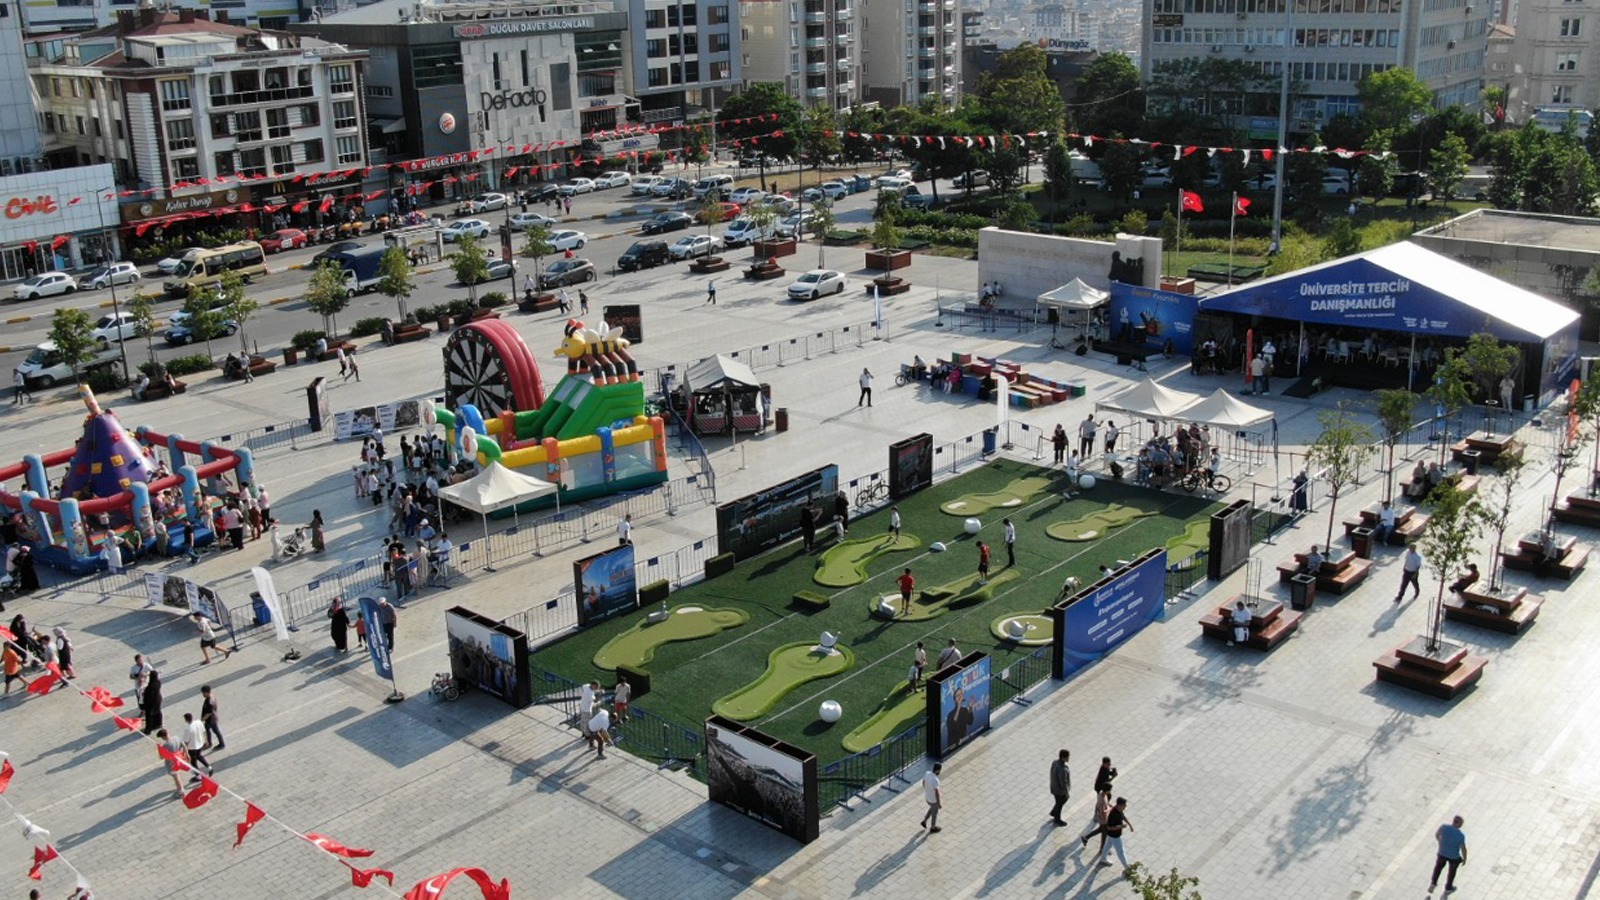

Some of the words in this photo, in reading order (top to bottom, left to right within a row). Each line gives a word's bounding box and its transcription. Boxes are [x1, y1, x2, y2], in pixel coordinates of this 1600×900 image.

[1048, 38, 1090, 50] Dünyagöz
[480, 86, 547, 112] DeFacto
[1299, 280, 1366, 297] ÜNİVERSİTE
[1367, 277, 1411, 294] TERCİH
[1310, 294, 1397, 314] DANIŞMANLIĞI
